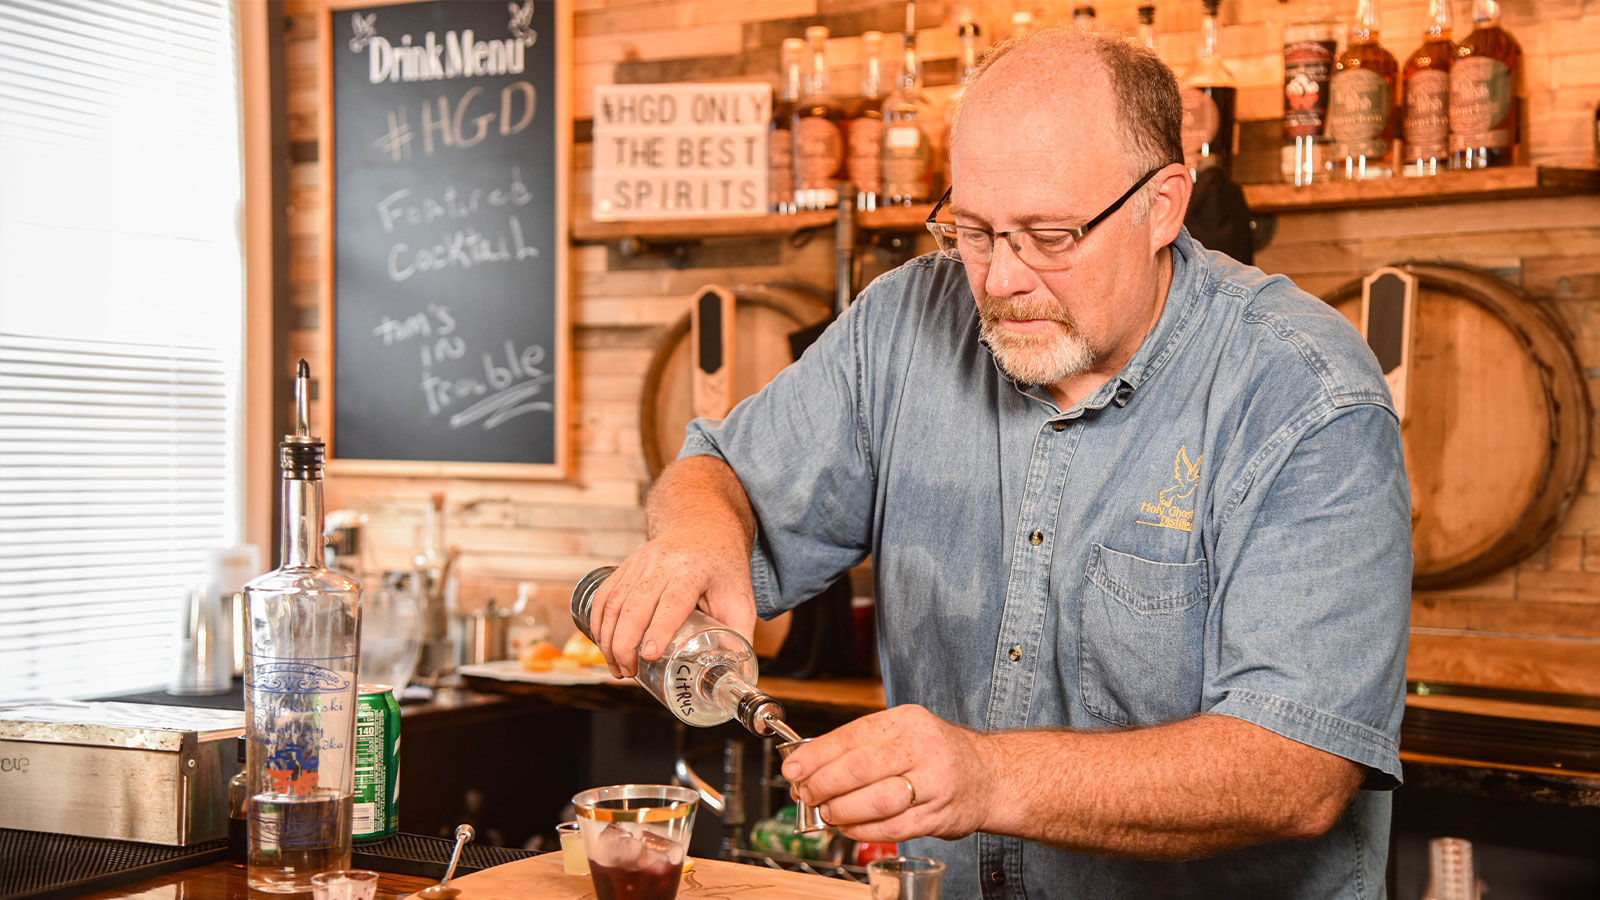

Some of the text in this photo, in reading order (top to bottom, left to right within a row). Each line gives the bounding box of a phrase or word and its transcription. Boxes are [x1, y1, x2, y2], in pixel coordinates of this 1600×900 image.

[369, 29, 525, 83] Drink Menu
[371, 81, 537, 162] #HGD
[692, 93, 768, 124] ONLY
[614, 137, 758, 167] THE BEST
[615, 180, 758, 210] SPIRITS
[1140, 501, 1166, 517] Holy
[358, 727, 374, 735] 140
